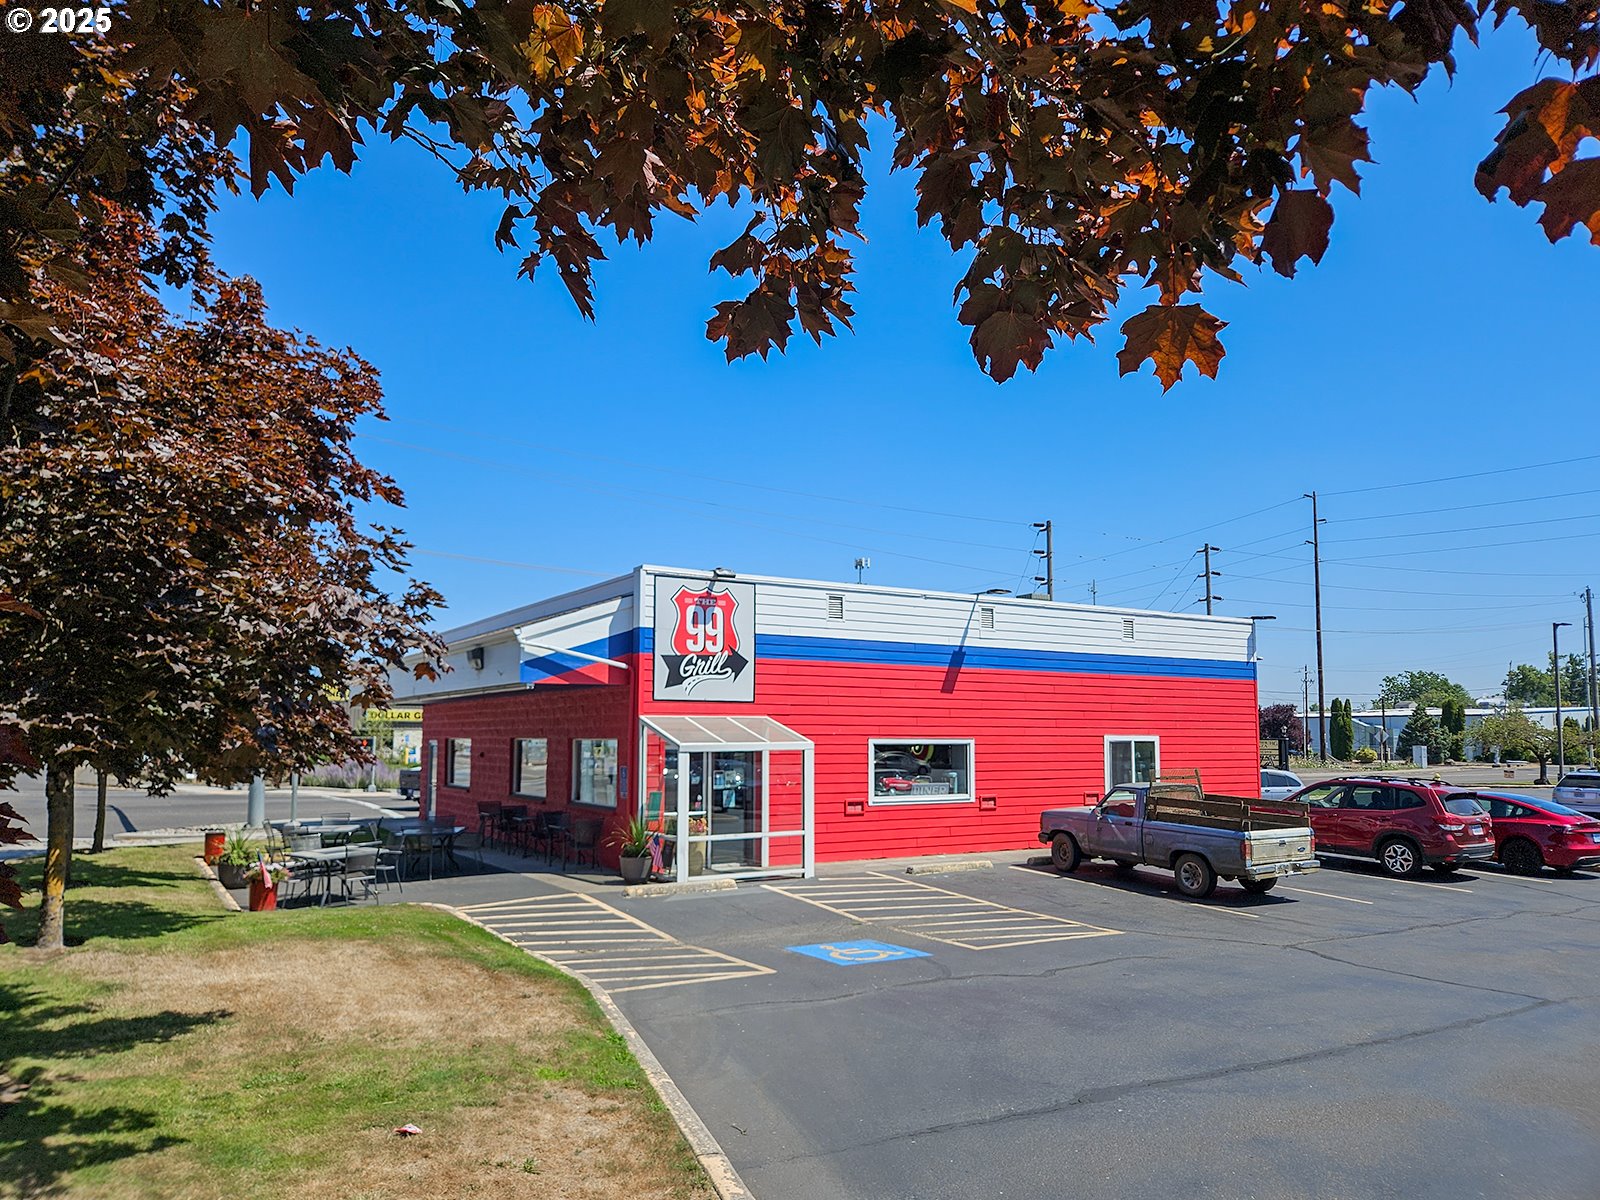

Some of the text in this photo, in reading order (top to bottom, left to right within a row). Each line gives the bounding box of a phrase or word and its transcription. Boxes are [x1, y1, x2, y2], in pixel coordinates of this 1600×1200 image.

[694, 597, 717, 606] THE
[686, 604, 724, 653] 99
[680, 650, 732, 678] Grill
[370, 711, 411, 720] DOLLAR
[914, 784, 947, 795] DINER
